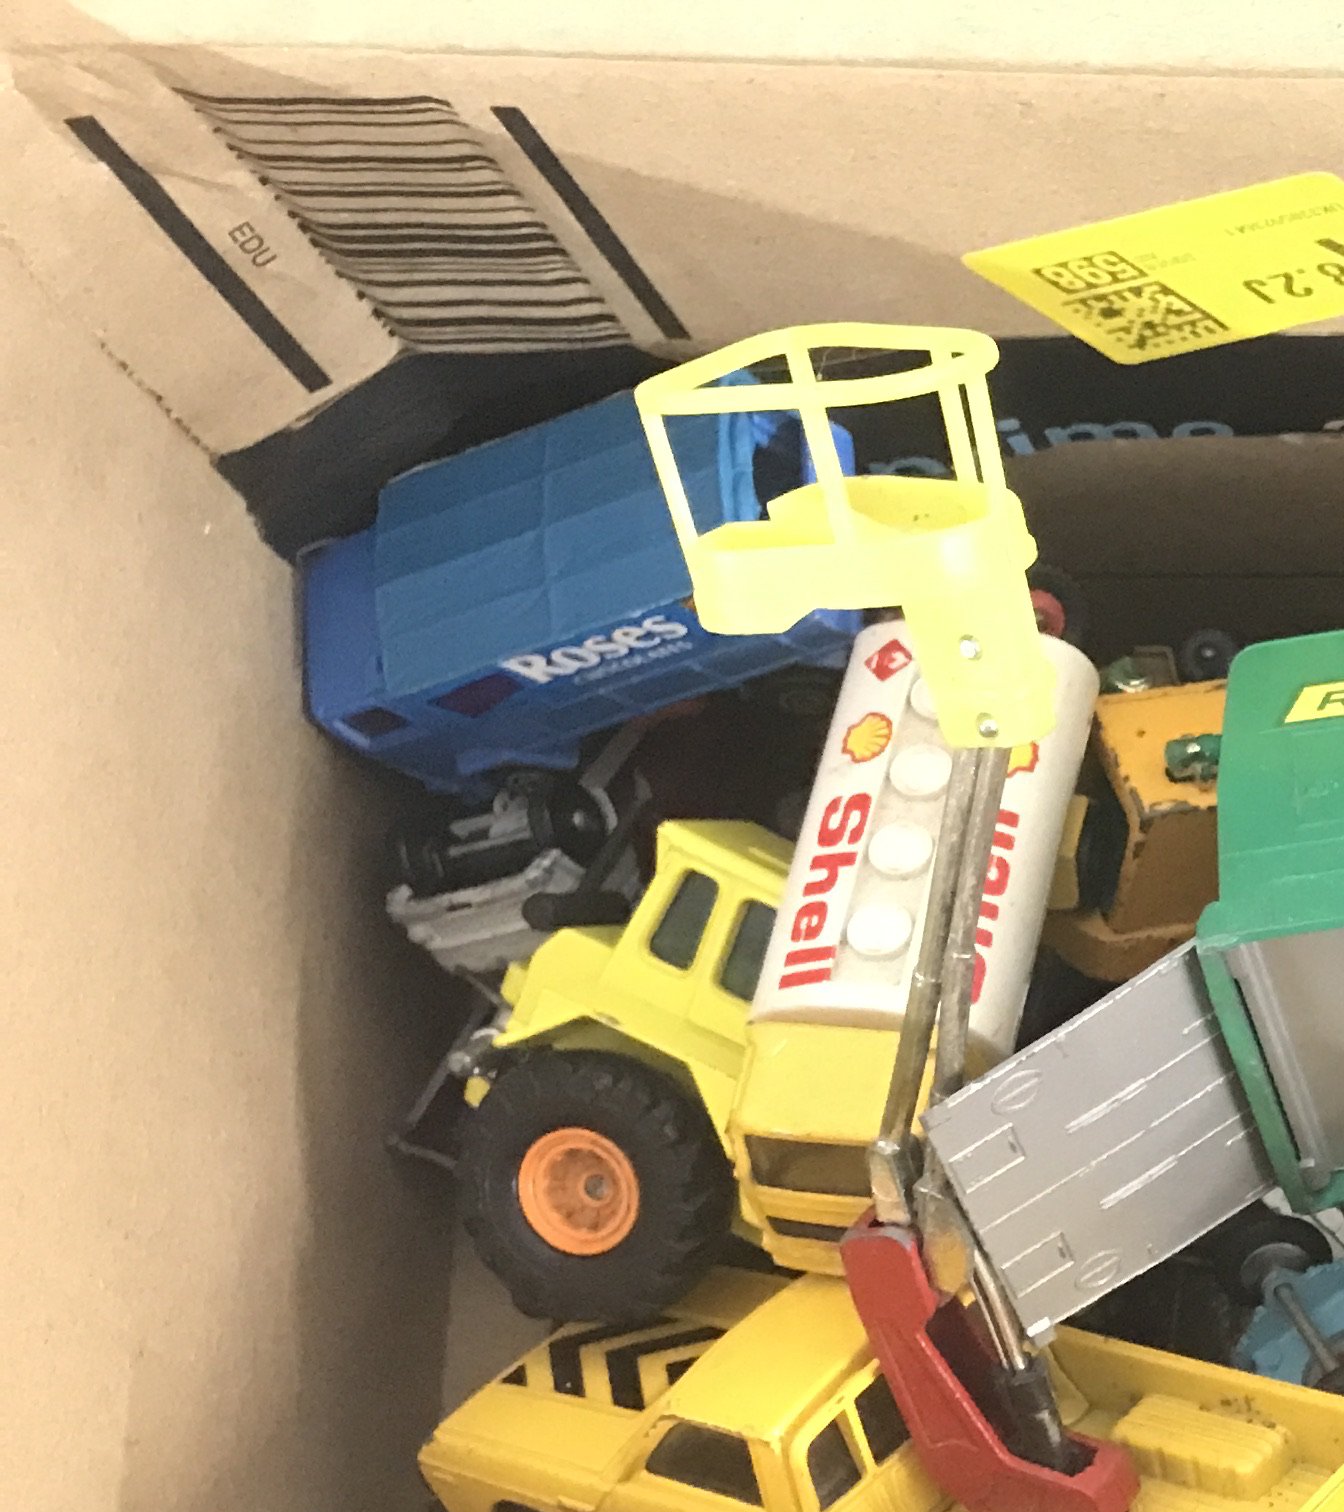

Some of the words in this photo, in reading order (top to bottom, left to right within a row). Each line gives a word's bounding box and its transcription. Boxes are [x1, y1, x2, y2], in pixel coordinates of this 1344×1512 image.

[228, 221, 277, 267] EDU
[1041, 254, 1138, 290] 598
[501, 615, 688, 684] Roses
[778, 793, 872, 990] Shell
